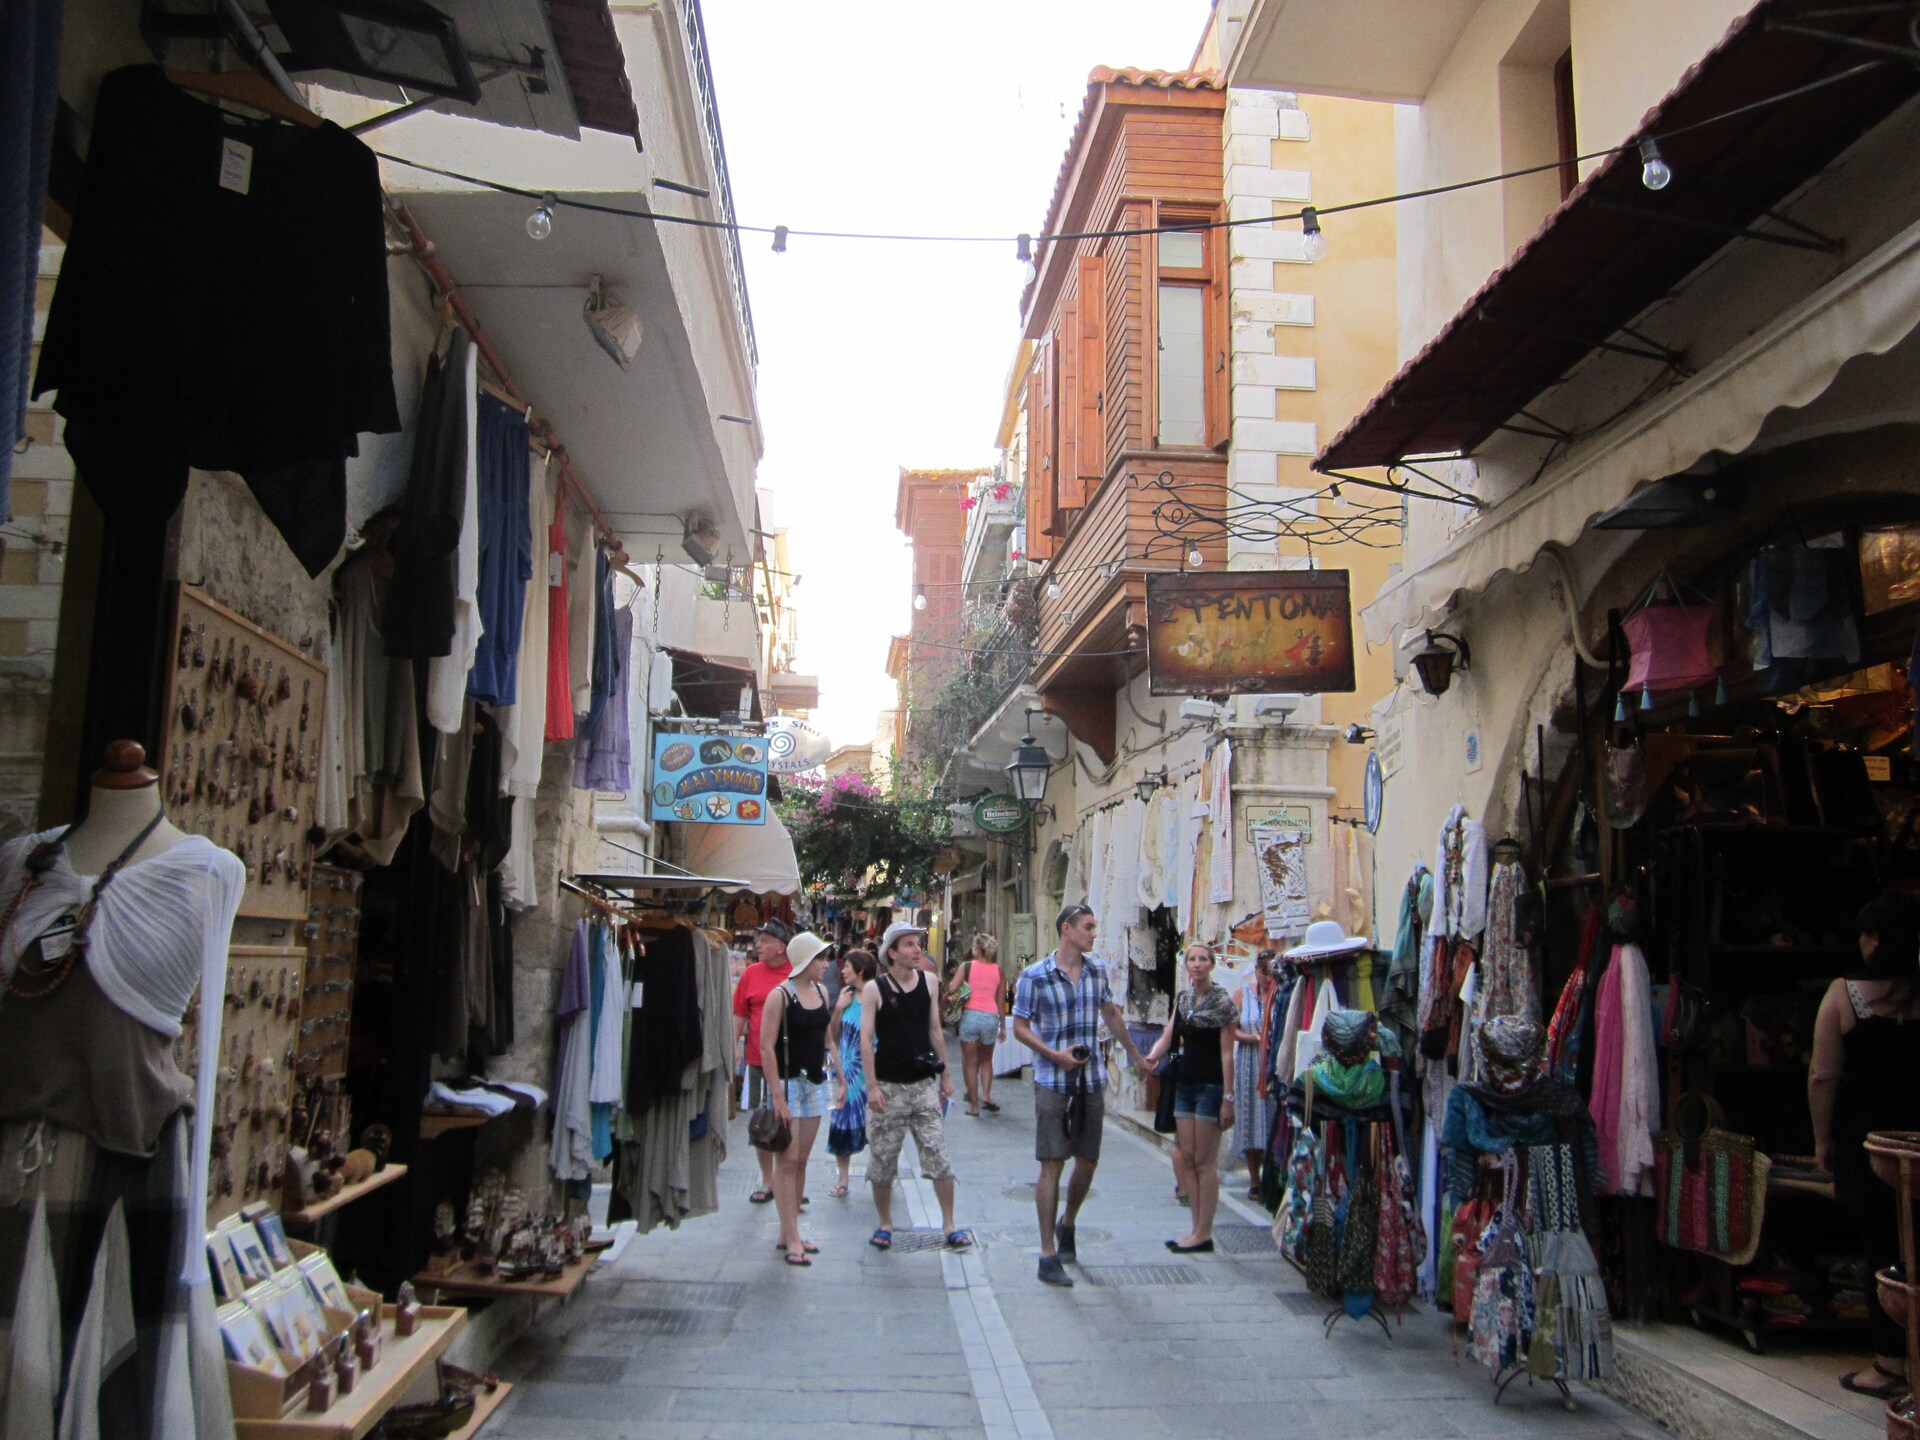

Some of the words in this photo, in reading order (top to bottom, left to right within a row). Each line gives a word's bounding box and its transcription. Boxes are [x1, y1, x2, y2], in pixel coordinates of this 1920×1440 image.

[768, 758, 810, 769] YSTALS
[680, 768, 762, 793] KALYMNOS
[986, 810, 1018, 818] Heineken
